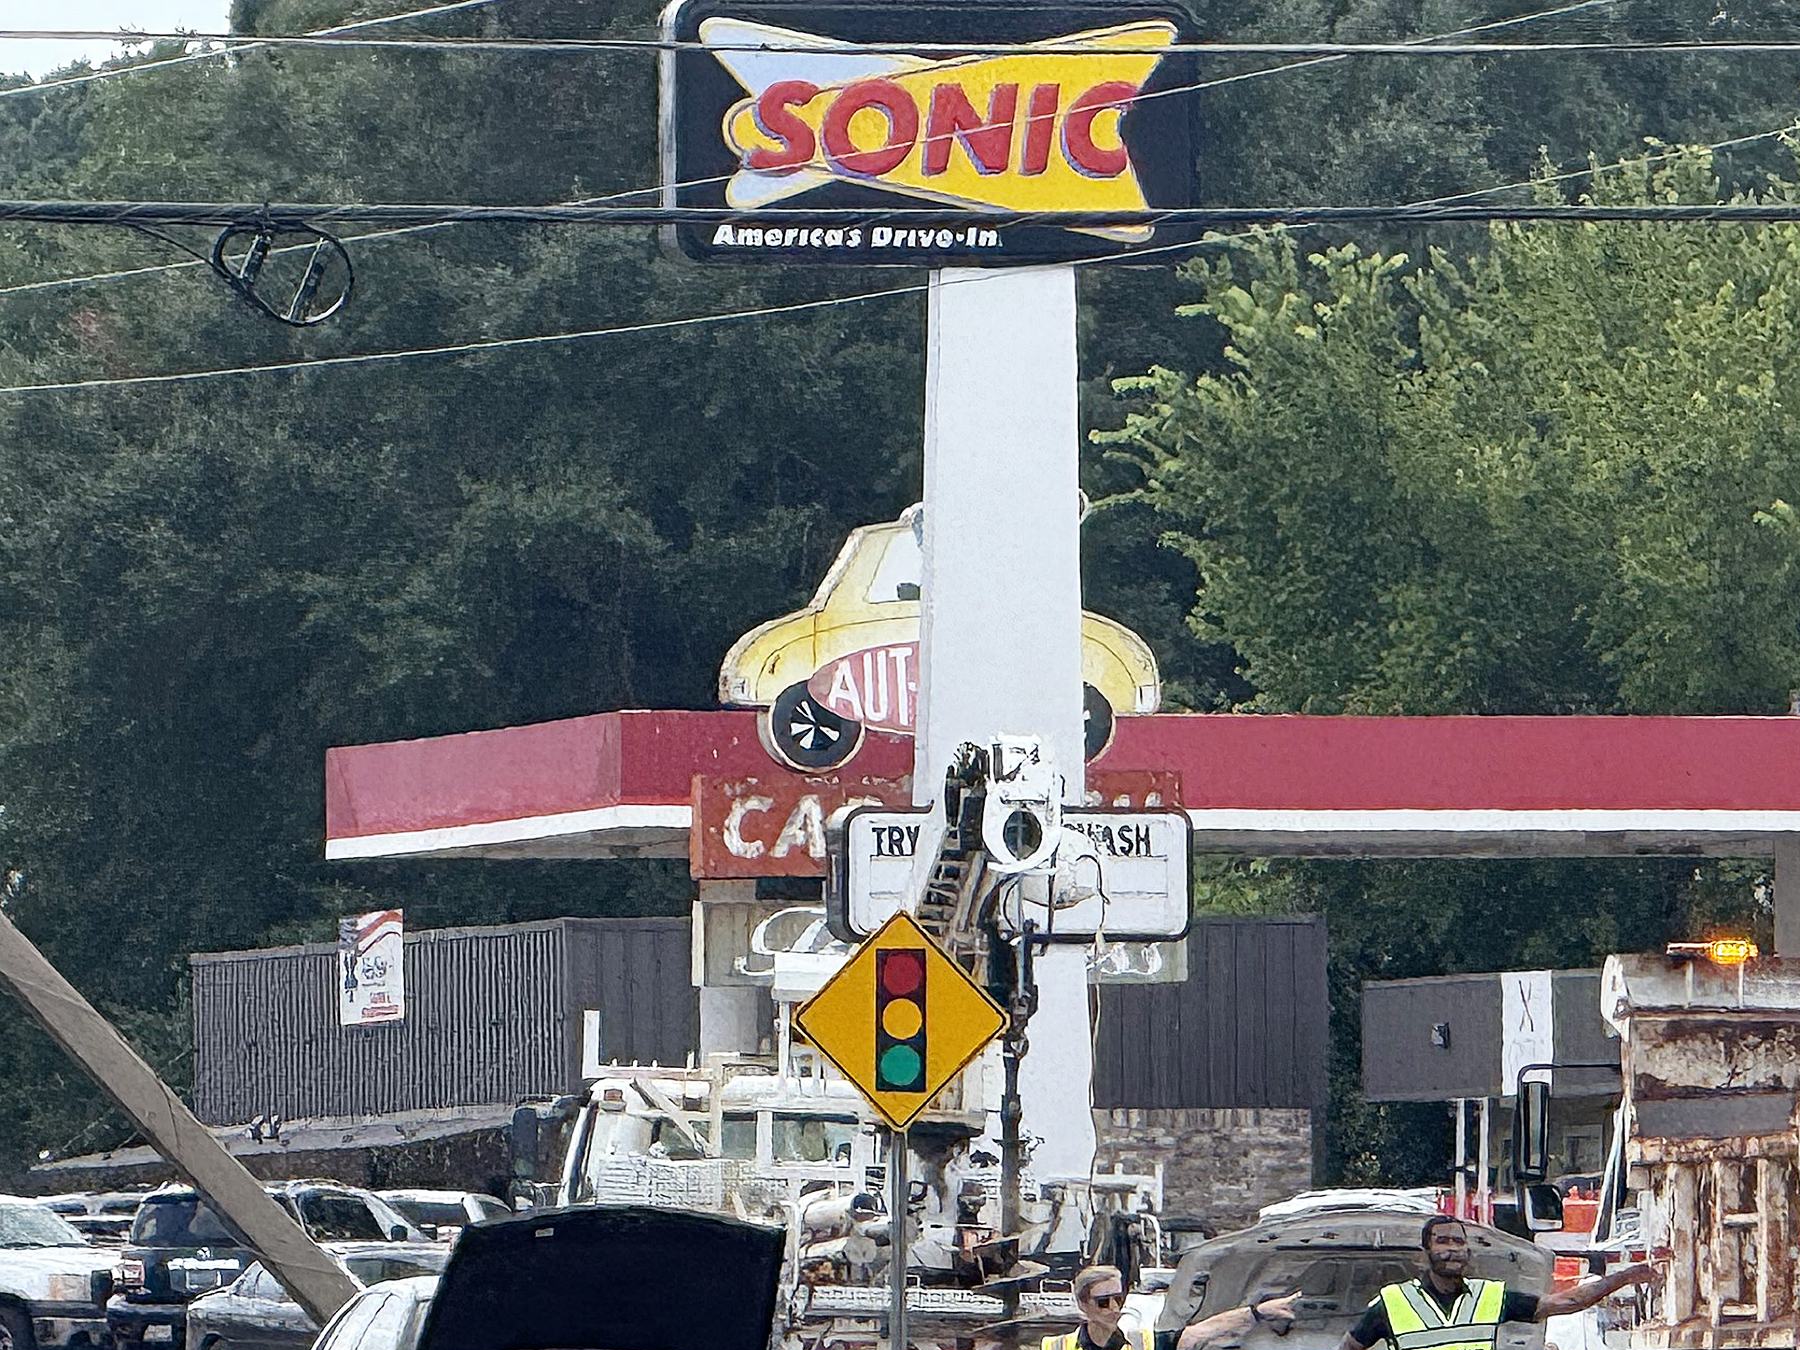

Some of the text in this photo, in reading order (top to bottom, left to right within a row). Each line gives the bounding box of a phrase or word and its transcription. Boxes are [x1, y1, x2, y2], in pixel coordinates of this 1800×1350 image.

[740, 79, 1138, 178] SONIC
[712, 224, 862, 248] America's
[828, 647, 917, 727] AUT
[871, 825, 920, 856] TRY
